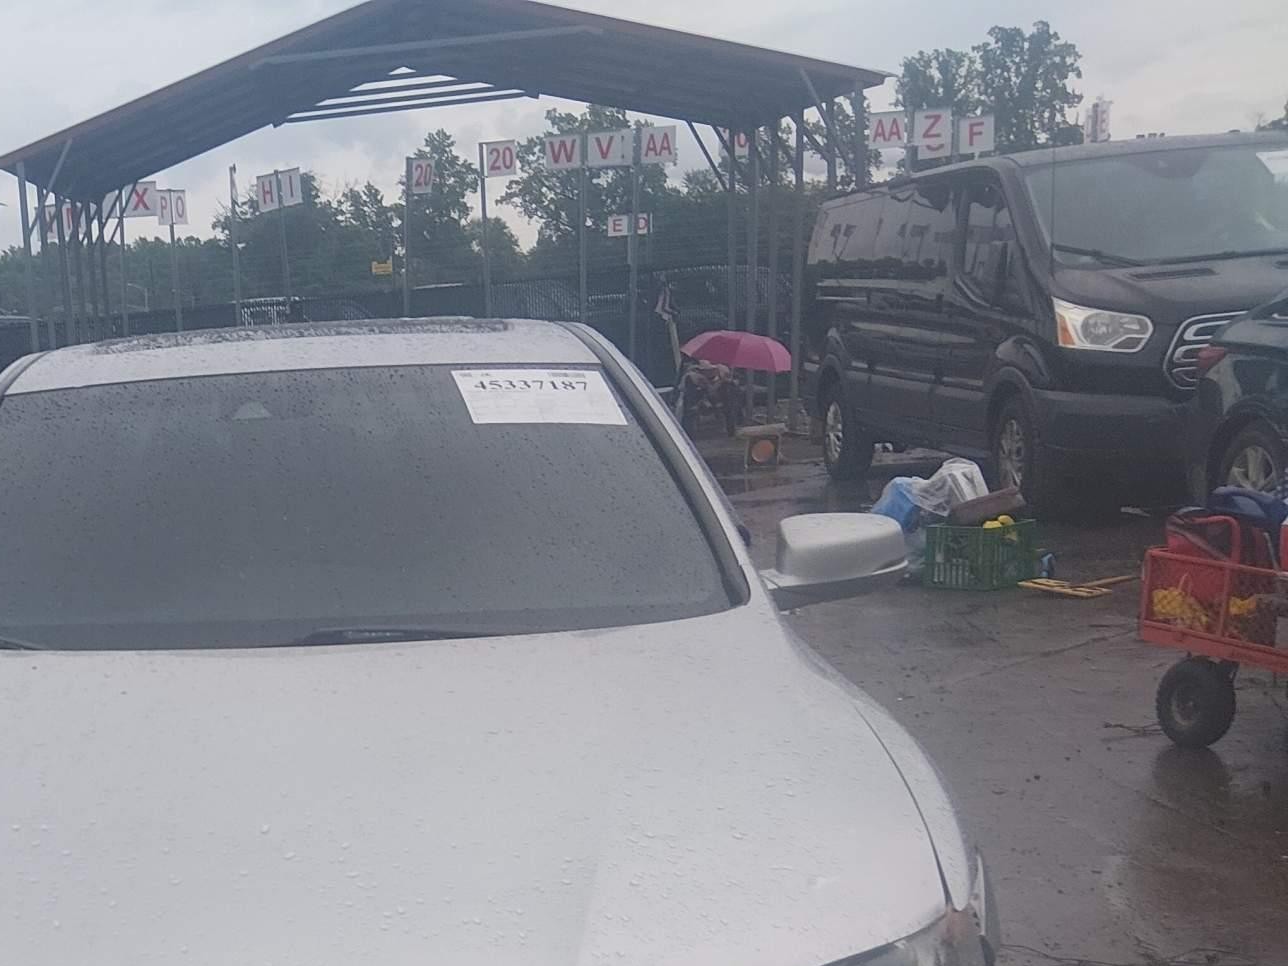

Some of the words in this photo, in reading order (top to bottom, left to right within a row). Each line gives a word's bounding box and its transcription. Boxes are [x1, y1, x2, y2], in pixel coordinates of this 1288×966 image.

[872, 118, 902, 143] AA
[922, 114, 943, 138] Z
[968, 121, 985, 146] F
[549, 138, 576, 164] W
[595, 136, 614, 160] V
[644, 132, 673, 157] AA
[488, 146, 512, 171] 20
[414, 163, 432, 187] 20
[132, 187, 150, 211] X
[262, 178, 273, 204] H
[612, 218, 623, 232] E
[474, 379, 588, 391] 45337187
